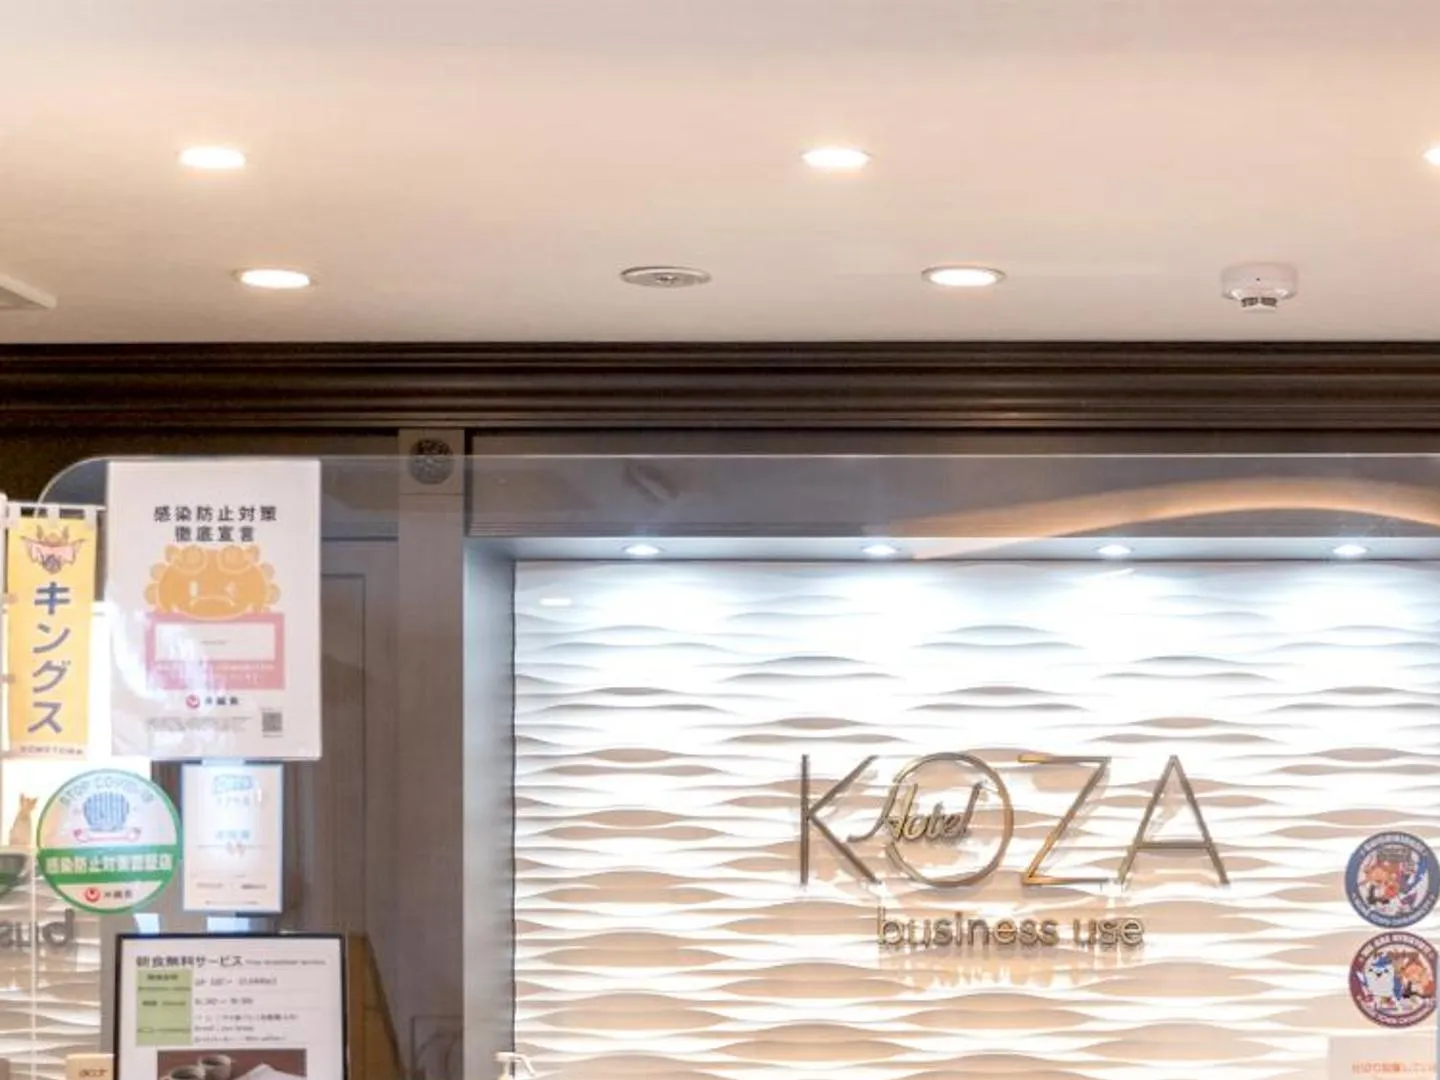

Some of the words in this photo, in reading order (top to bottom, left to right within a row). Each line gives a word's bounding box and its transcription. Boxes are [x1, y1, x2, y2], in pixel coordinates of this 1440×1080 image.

[153, 505, 278, 522] 感染防止対策
[26, 581, 71, 735] キングス
[800, 752, 1230, 888] KOZA
[847, 781, 985, 844] Hotel
[876, 906, 1061, 948] business
[1073, 917, 1147, 948] use
